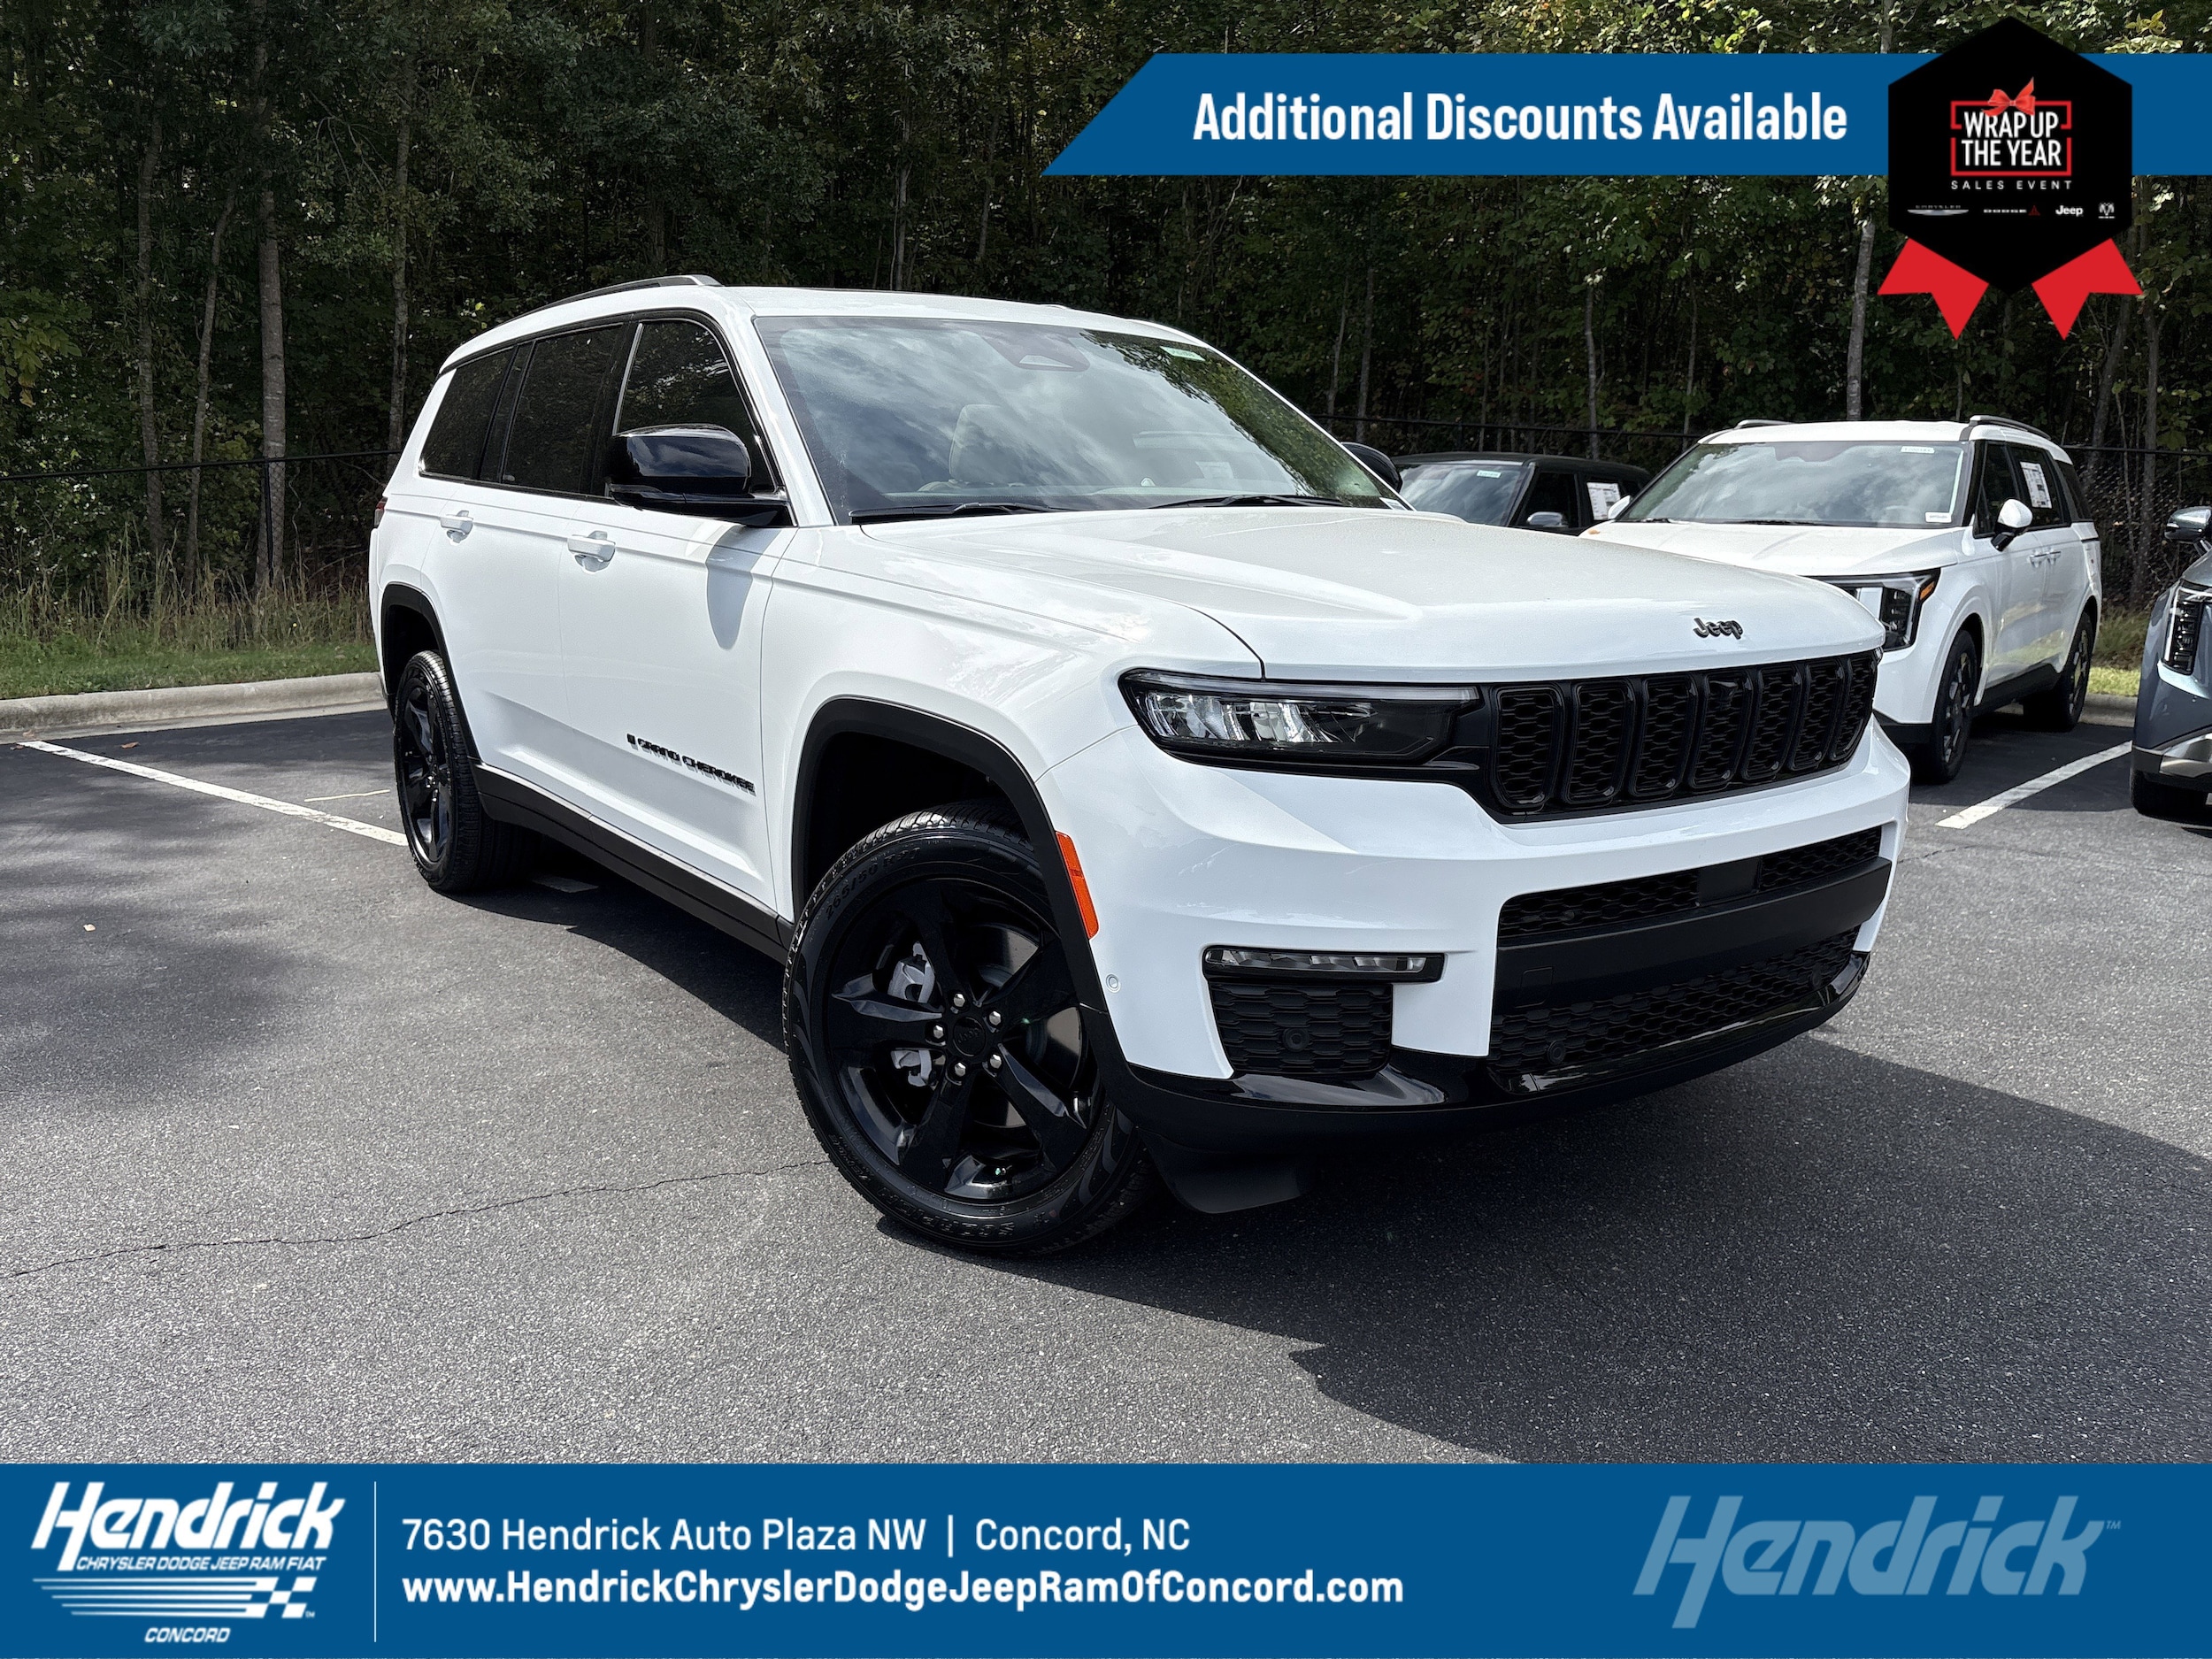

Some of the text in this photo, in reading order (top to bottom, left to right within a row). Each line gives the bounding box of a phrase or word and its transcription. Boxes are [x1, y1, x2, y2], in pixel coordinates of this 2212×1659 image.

[1694, 618, 1743, 640] Jeep
[637, 738, 756, 794] GRAND CHEROKEE
